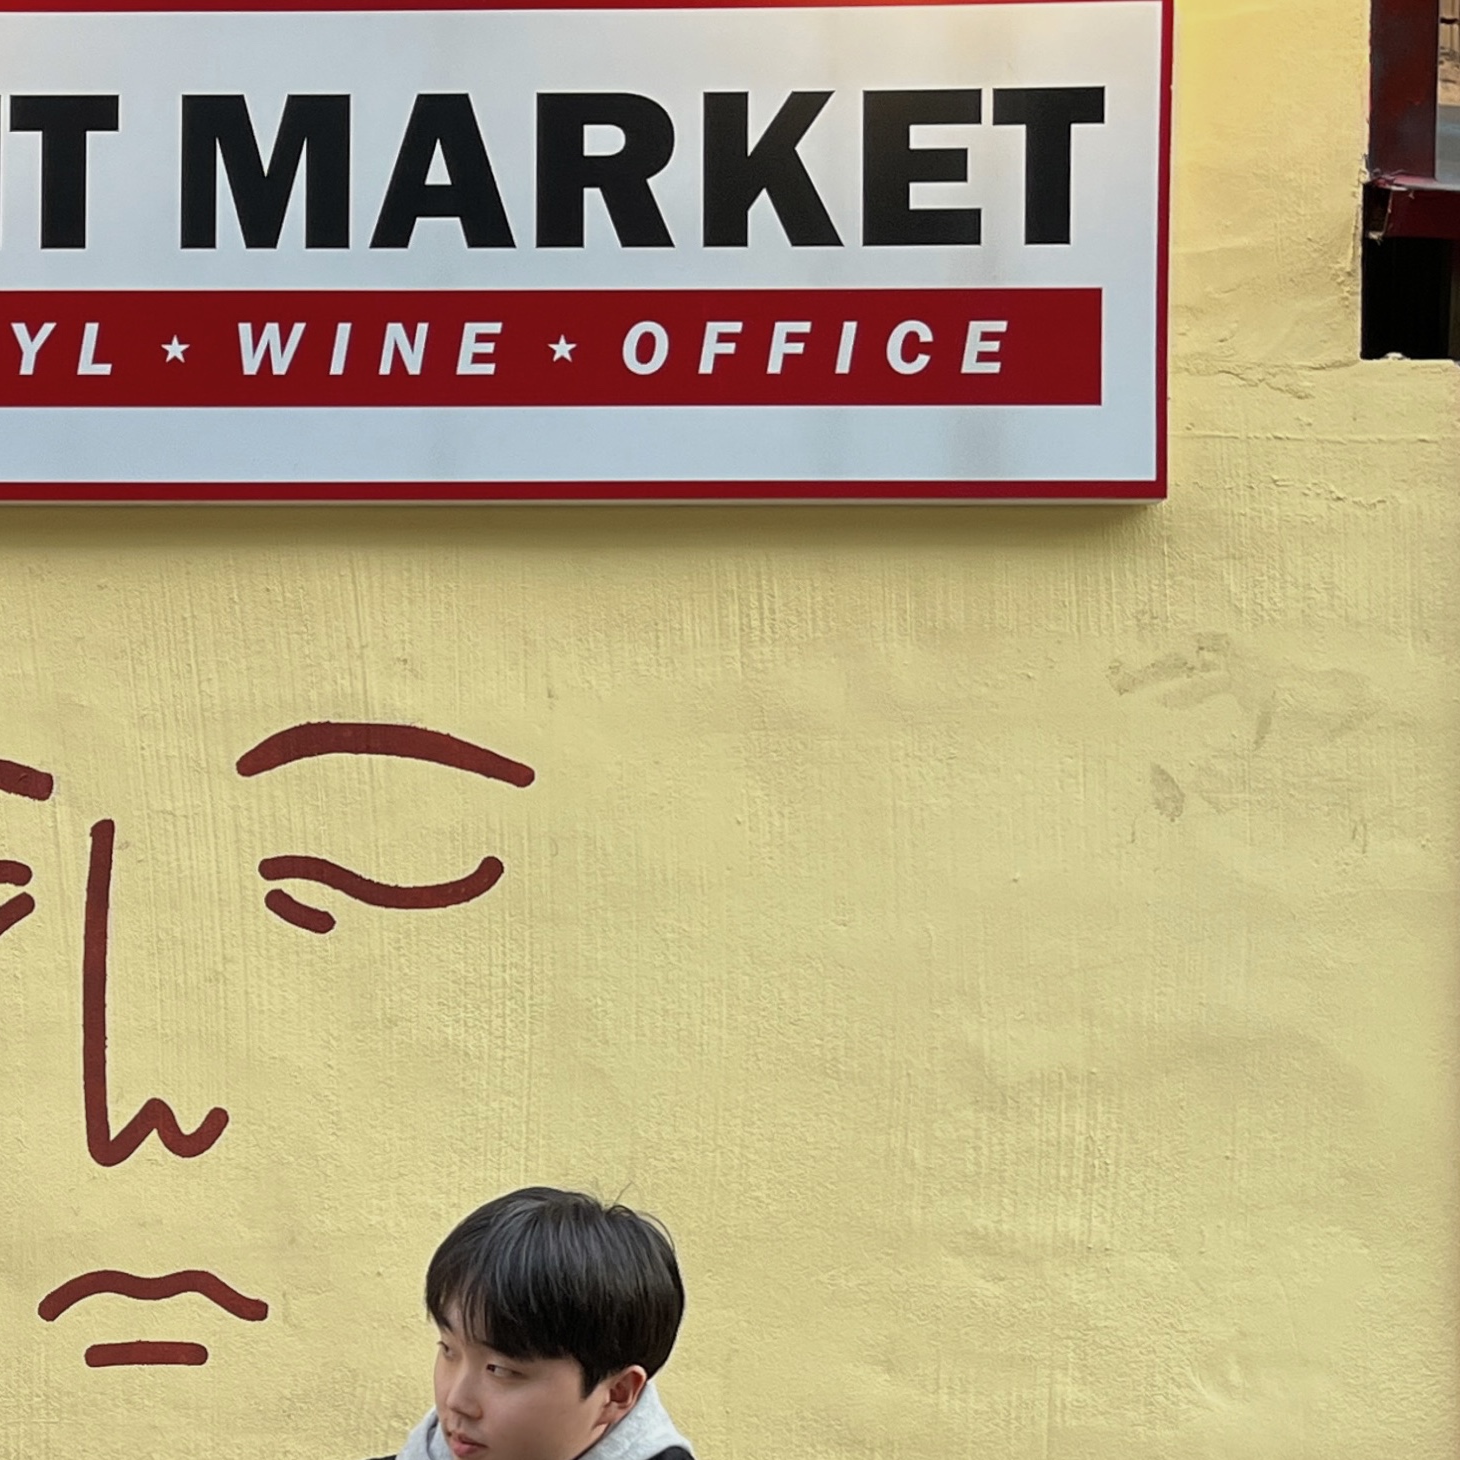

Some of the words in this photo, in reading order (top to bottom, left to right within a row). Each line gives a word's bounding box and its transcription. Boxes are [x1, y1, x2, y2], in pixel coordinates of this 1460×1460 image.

[180, 87, 1105, 249] MARKET
[237, 322, 503, 376] WINE
[622, 320, 1008, 375] OFFICE
